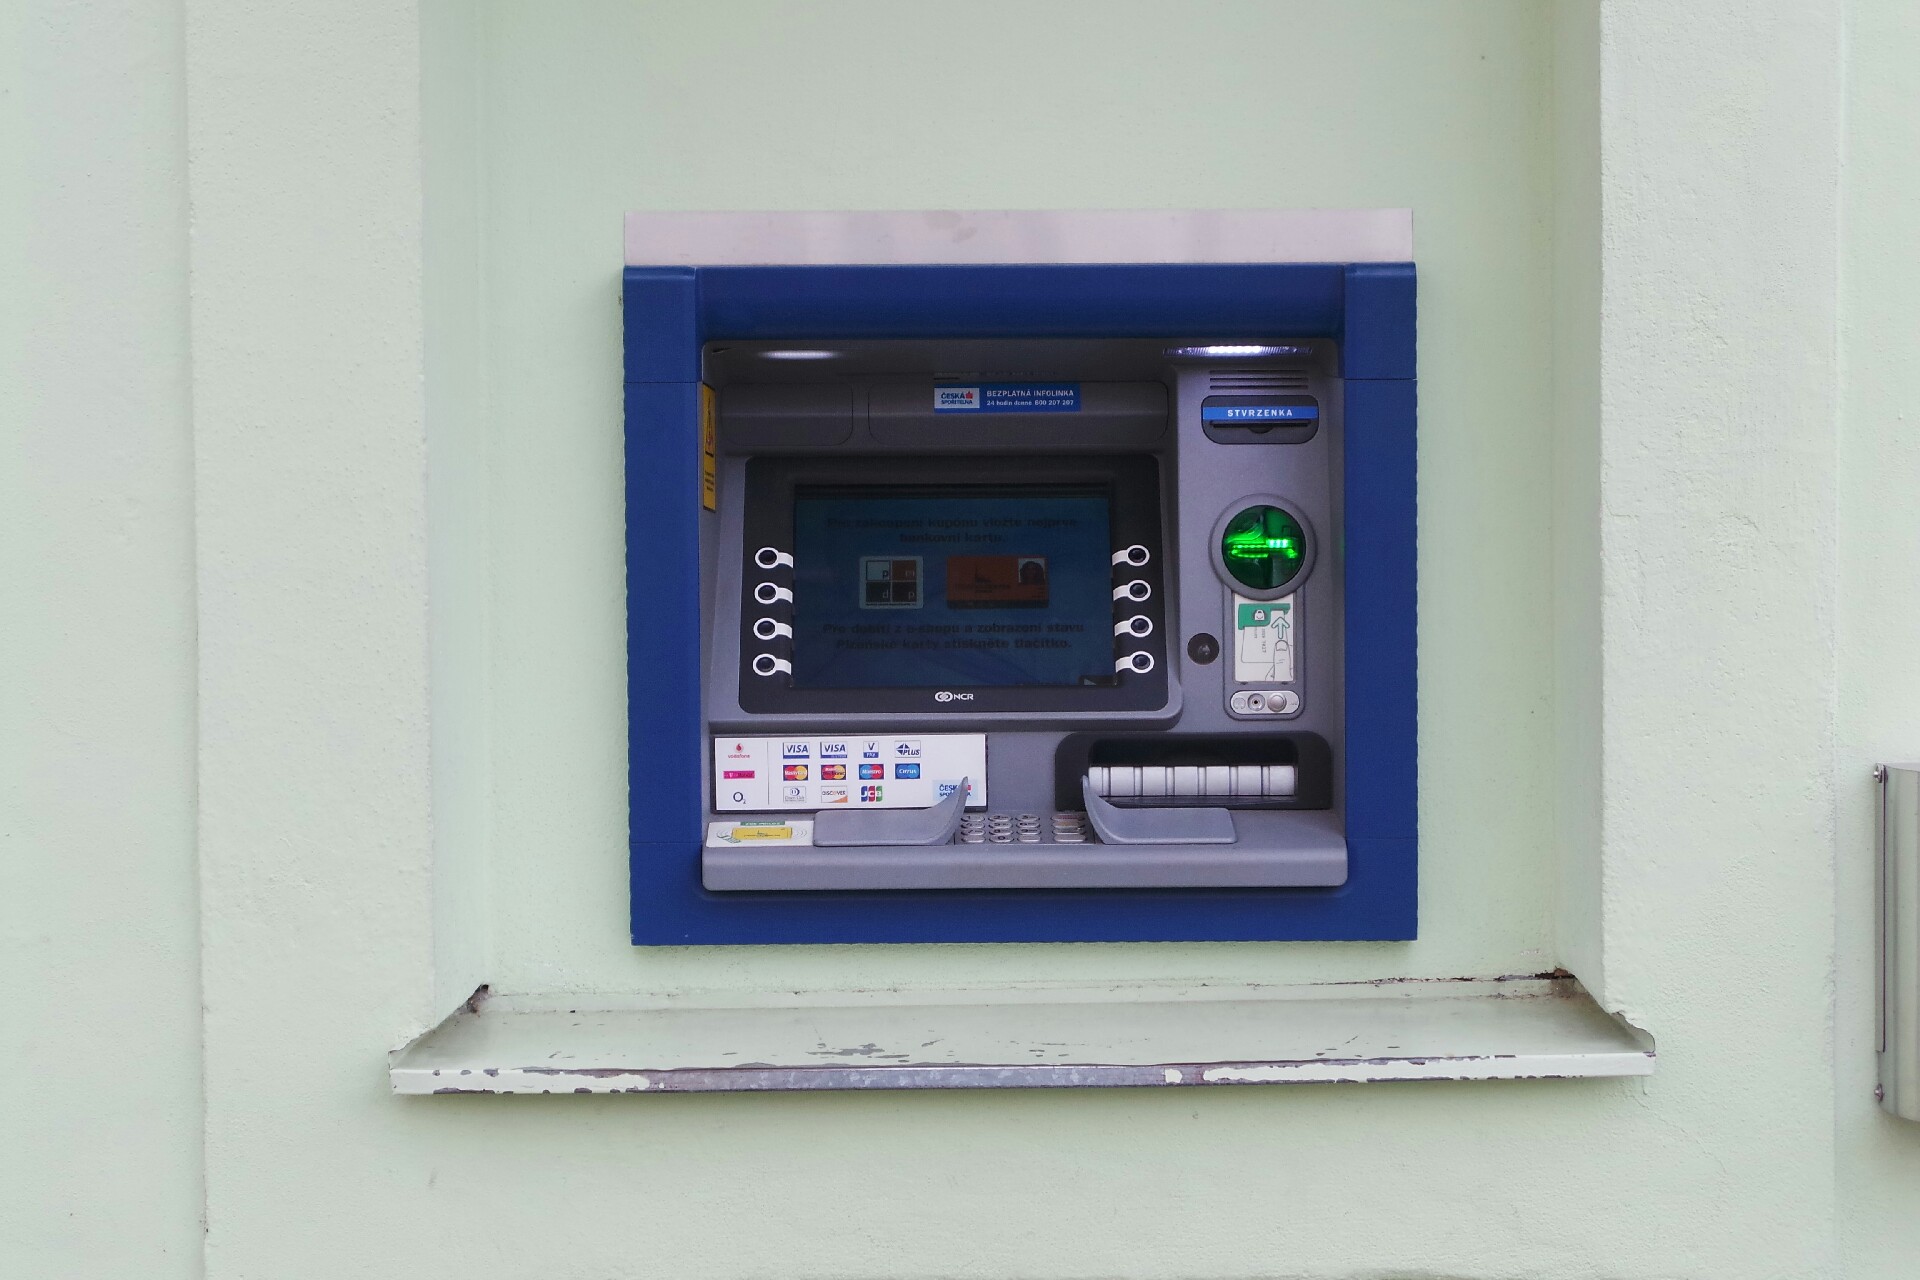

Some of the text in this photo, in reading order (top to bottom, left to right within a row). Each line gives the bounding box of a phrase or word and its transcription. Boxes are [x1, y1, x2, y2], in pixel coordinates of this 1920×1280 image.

[941, 390, 965, 399] ČESKÁ
[986, 389, 1074, 397] BEZPLATNÁ INFOLINKA
[1227, 409, 1293, 417] STVRZENKA
[953, 693, 974, 701] NCR
[786, 745, 809, 754] VISA
[824, 744, 846, 753] VISA
[902, 748, 921, 756] PLUS
